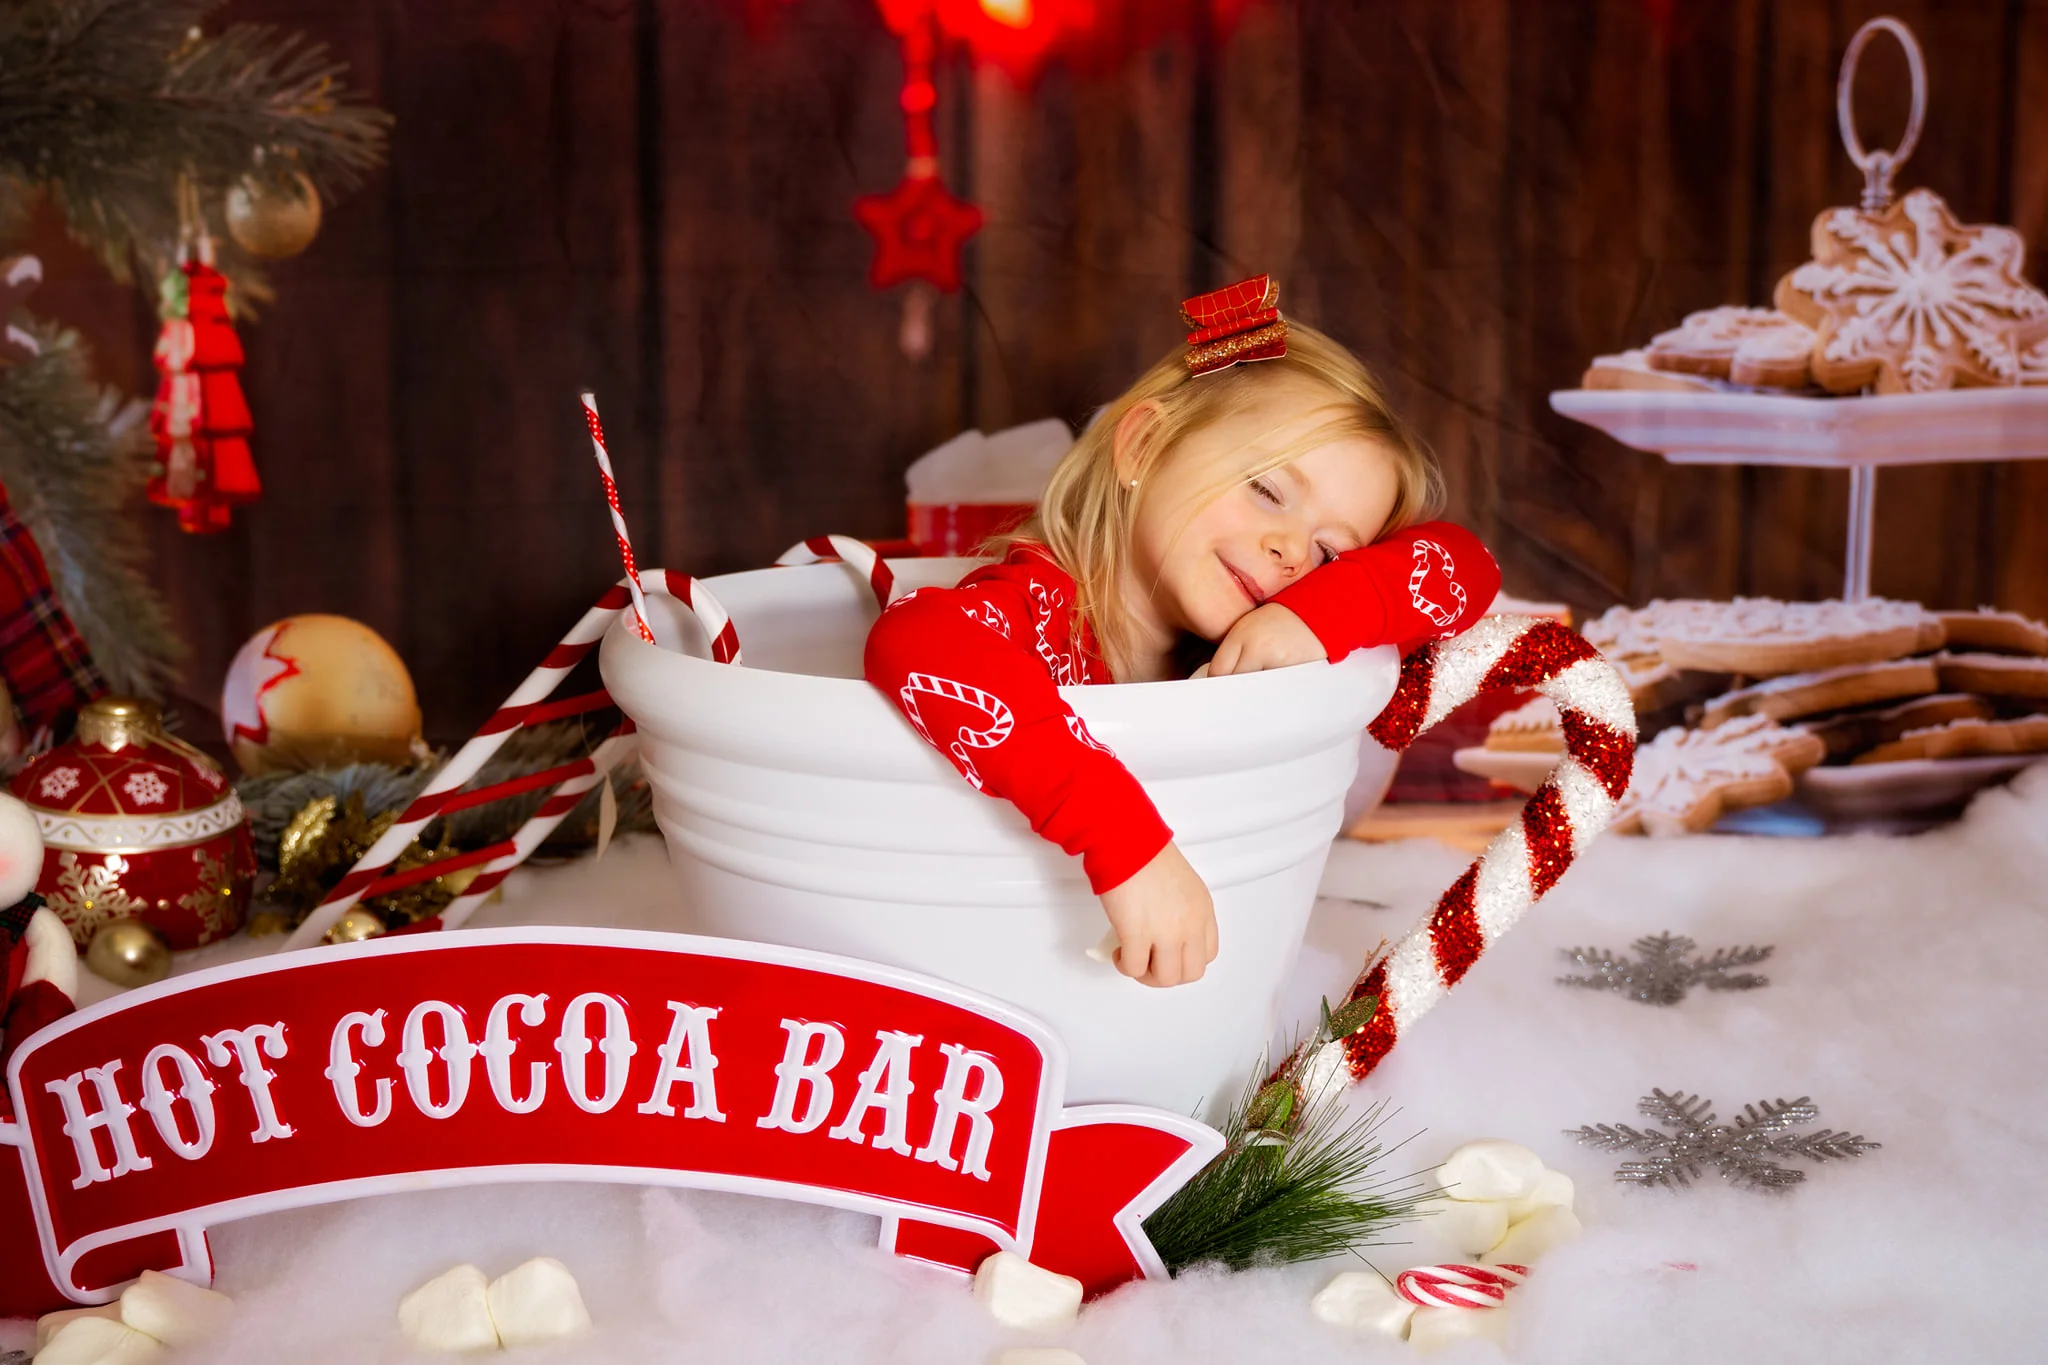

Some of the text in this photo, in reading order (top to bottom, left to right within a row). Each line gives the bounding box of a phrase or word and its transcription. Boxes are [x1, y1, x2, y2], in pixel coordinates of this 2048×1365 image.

[44, 991, 1005, 1190] HOT COCOA BAR
